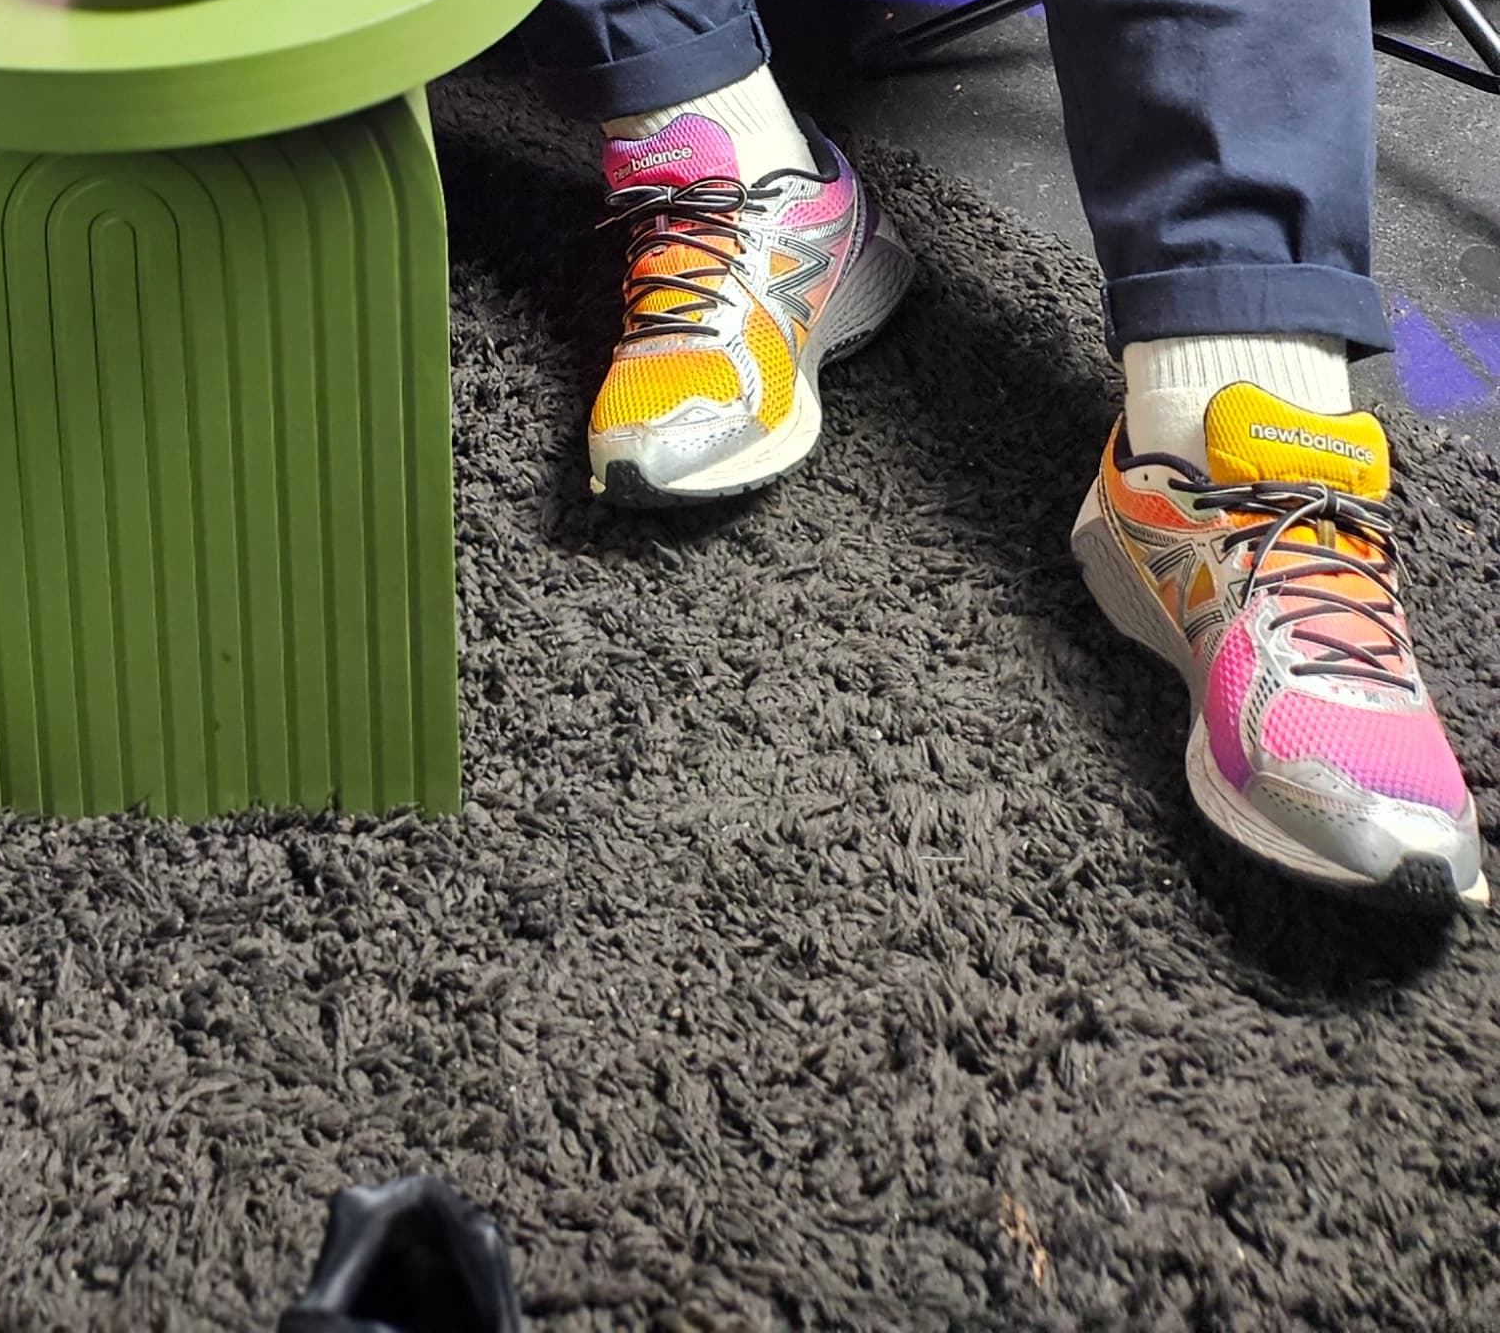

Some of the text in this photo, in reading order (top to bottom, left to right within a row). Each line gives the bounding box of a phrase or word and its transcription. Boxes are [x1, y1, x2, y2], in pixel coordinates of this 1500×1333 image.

[631, 146, 693, 172] balance
[1250, 423, 1375, 465] new balance
